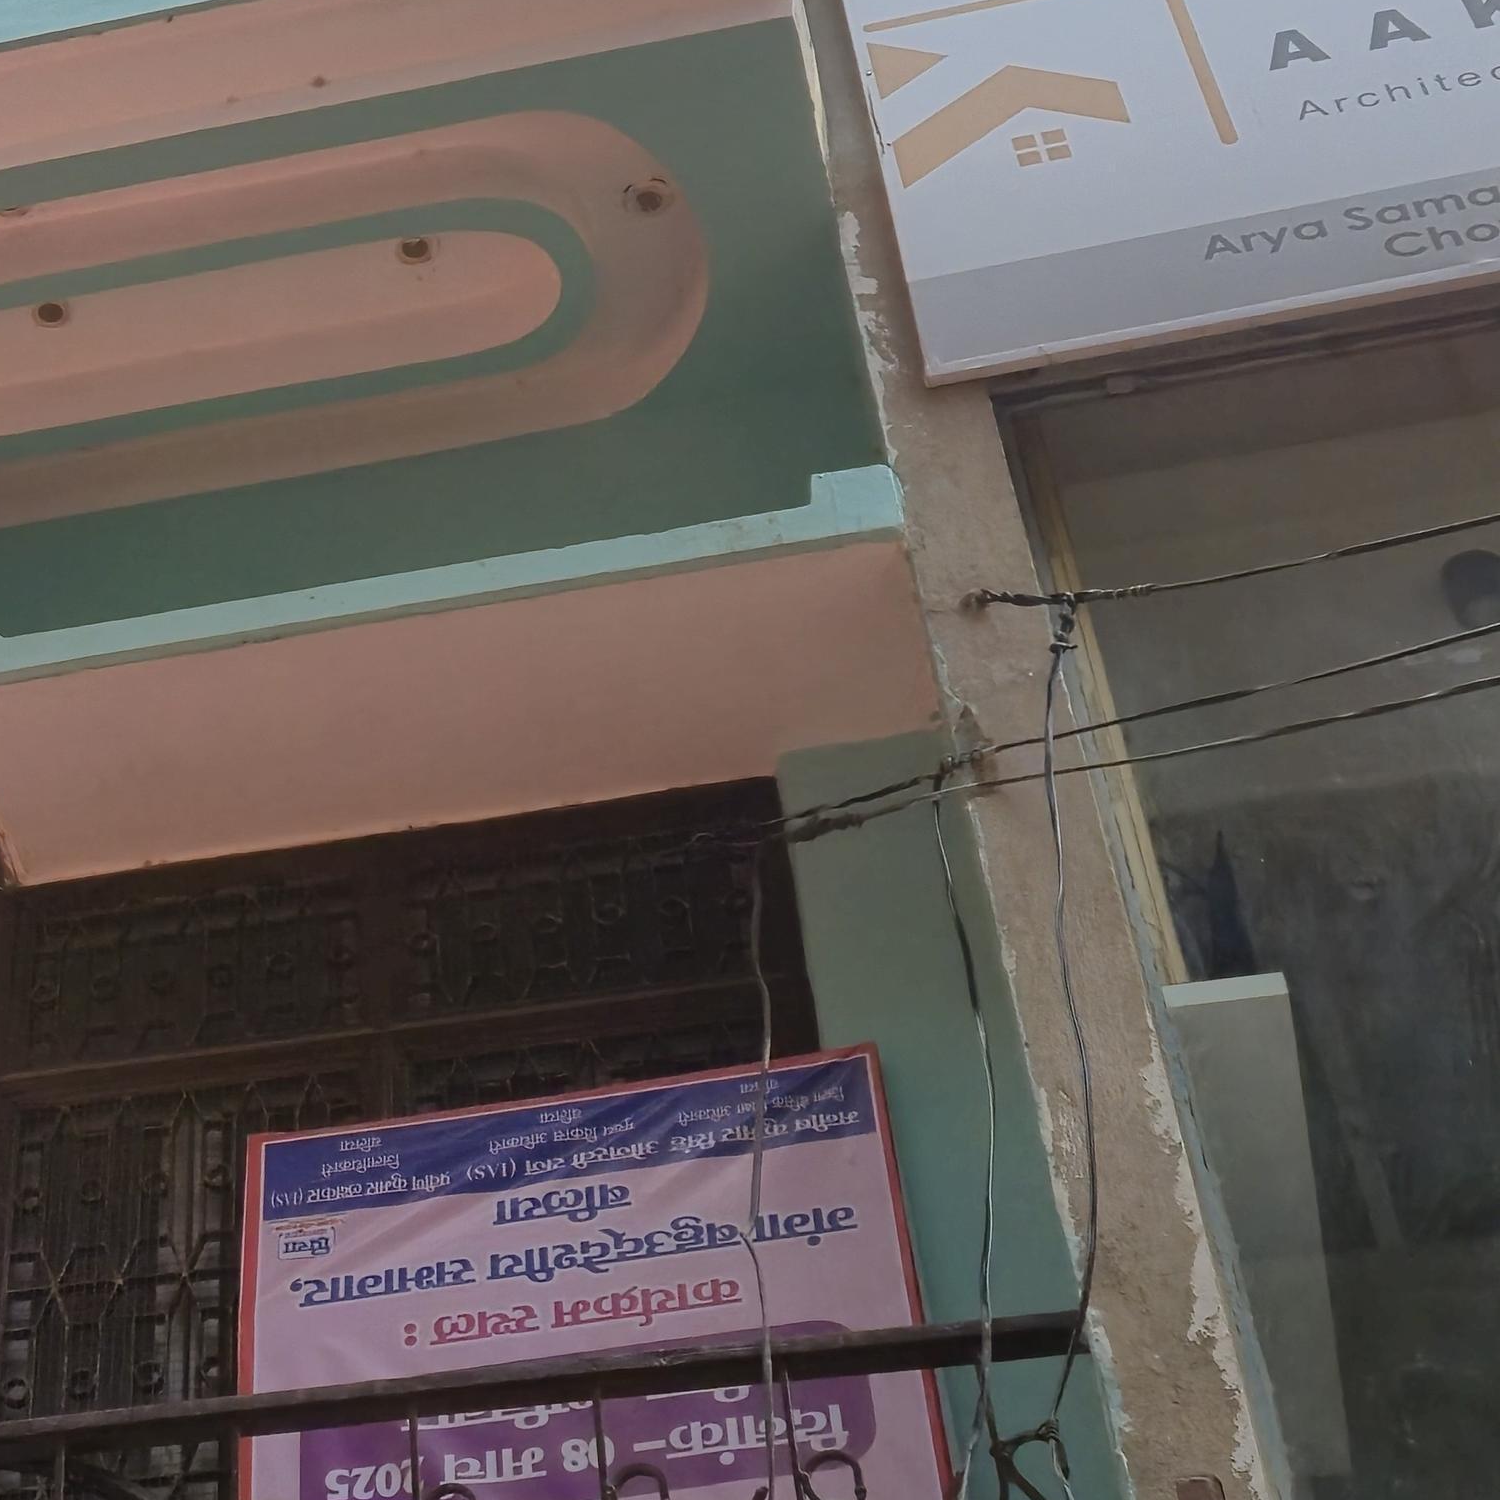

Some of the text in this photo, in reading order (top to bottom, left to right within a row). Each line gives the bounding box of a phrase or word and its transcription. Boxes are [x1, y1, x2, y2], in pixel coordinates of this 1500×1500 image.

[1204, 219, 1329, 261] Arya
[466, 1157, 518, 1182] (IAS)
[492, 1183, 633, 1227] बलिया
[752, 1206, 858, 1246] गंगा
[289, 1257, 477, 1308] सभागार,
[551, 1277, 743, 1331] कार्यक्रम
[430, 1305, 542, 1347] स्थल
